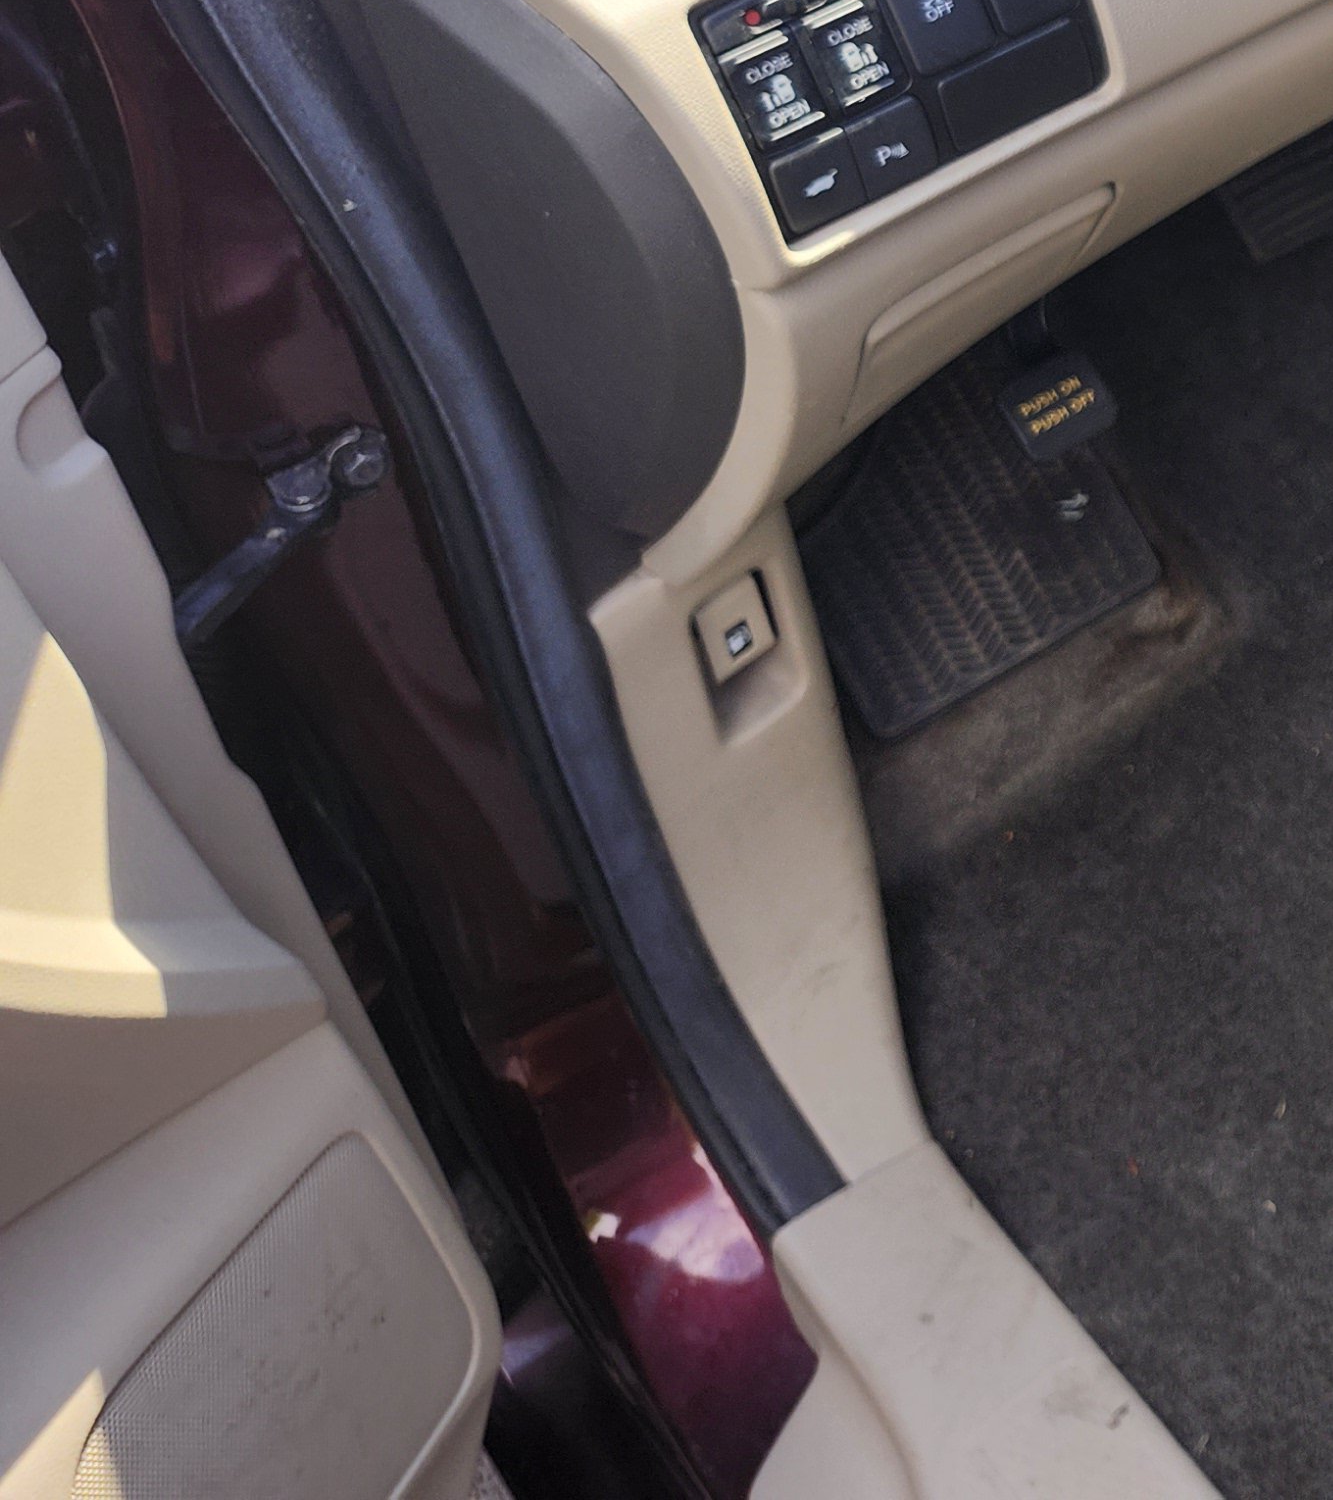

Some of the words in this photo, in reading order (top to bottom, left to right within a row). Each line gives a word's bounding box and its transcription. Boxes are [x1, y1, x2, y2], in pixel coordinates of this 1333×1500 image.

[827, 15, 874, 47] CLOSE
[745, 51, 794, 85] CLOSE
[850, 60, 890, 90] OPEN
[768, 98, 811, 129] OPEN
[1017, 388, 1060, 418] PUSH
[1056, 375, 1083, 397] ON
[1029, 405, 1070, 437] PUSH
